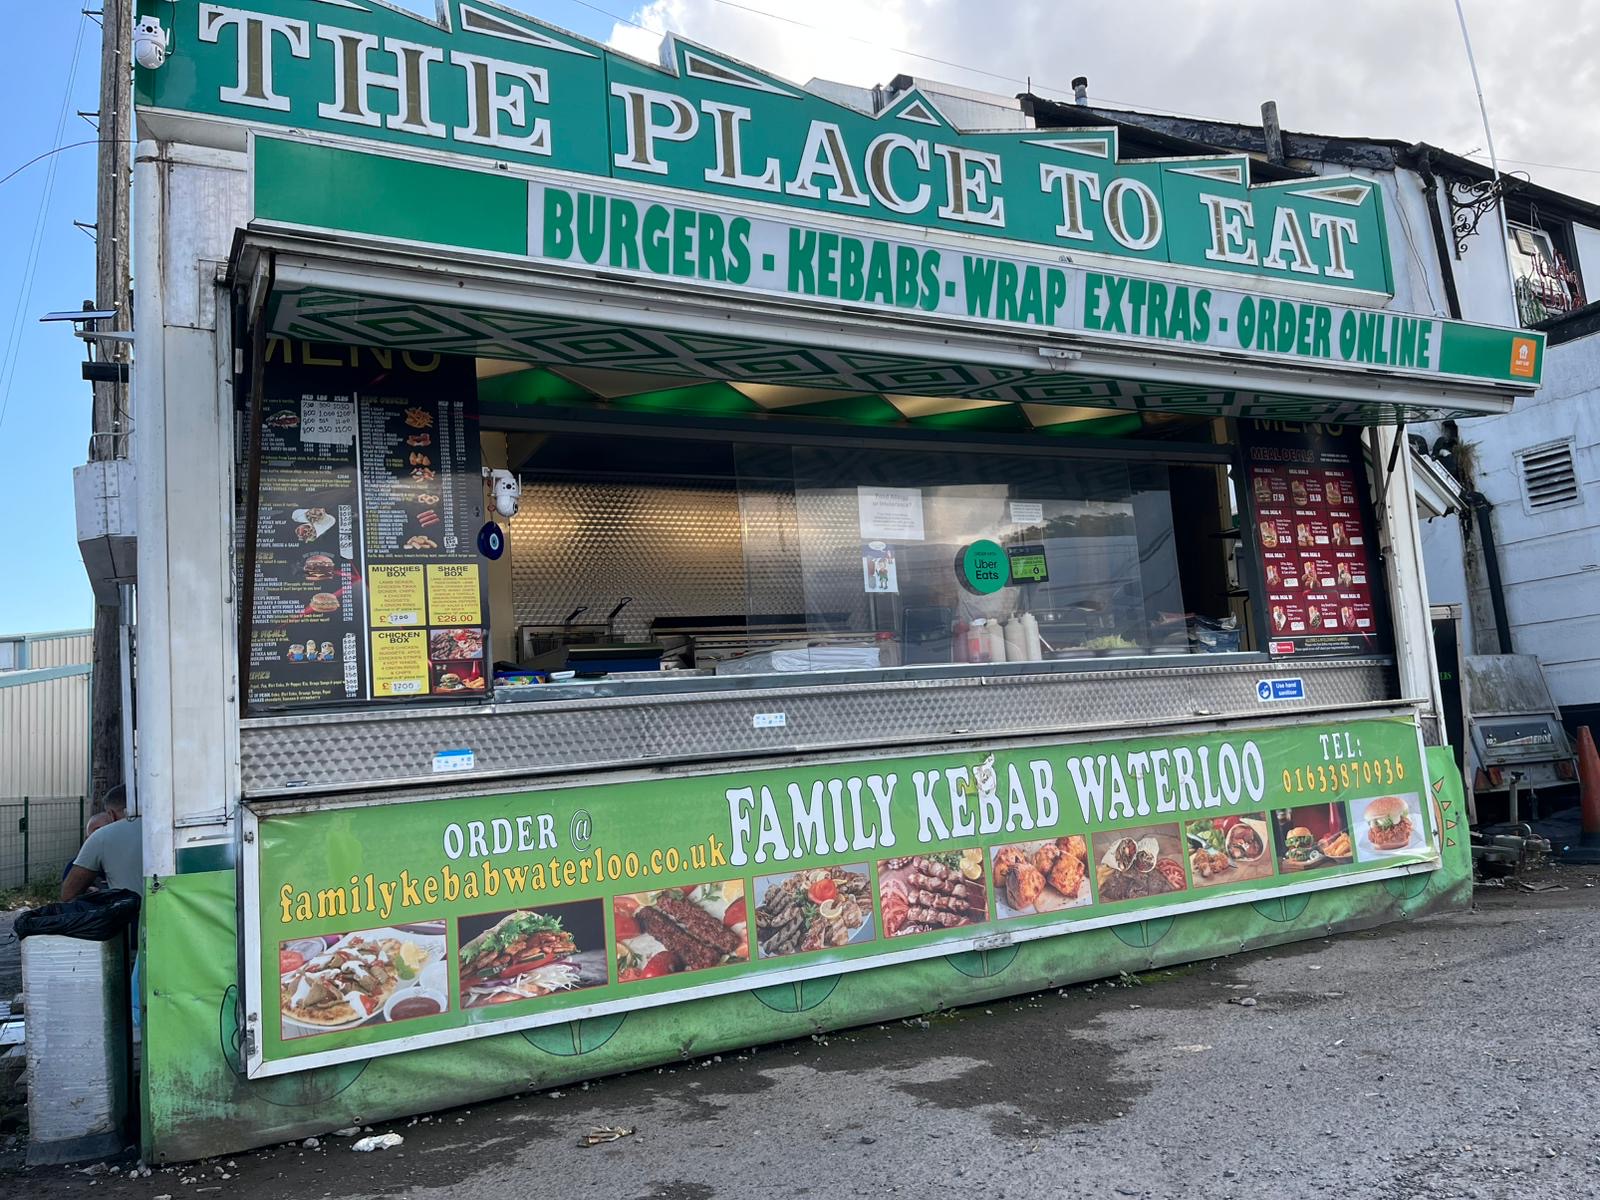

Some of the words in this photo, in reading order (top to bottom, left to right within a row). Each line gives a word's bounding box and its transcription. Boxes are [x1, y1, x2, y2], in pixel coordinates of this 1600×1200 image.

[198, 4, 552, 157] THE
[610, 81, 1006, 228] PLACE
[1039, 162, 1163, 252] TO
[1199, 192, 1359, 280] EAT
[543, 187, 751, 284] BURGERS
[787, 227, 942, 311] KEBABS
[962, 255, 1067, 326] WRAP
[1083, 272, 1211, 343] EXTRAS
[1236, 295, 1331, 359] ORDER
[1339, 309, 1433, 369] ONLINE
[974, 559, 998, 569] Uber
[976, 570, 1000, 580] Eats
[1319, 732, 1362, 761] TEL:
[1282, 755, 1405, 793] 01633870936
[725, 772, 898, 866] FAMILY
[912, 758, 1059, 842] KEBAB
[1066, 739, 1265, 825] WATERLOO
[442, 813, 558, 860] ORDER
[569, 808, 593, 852] @
[280, 833, 726, 923] familykebabwaterloo.co.uk
